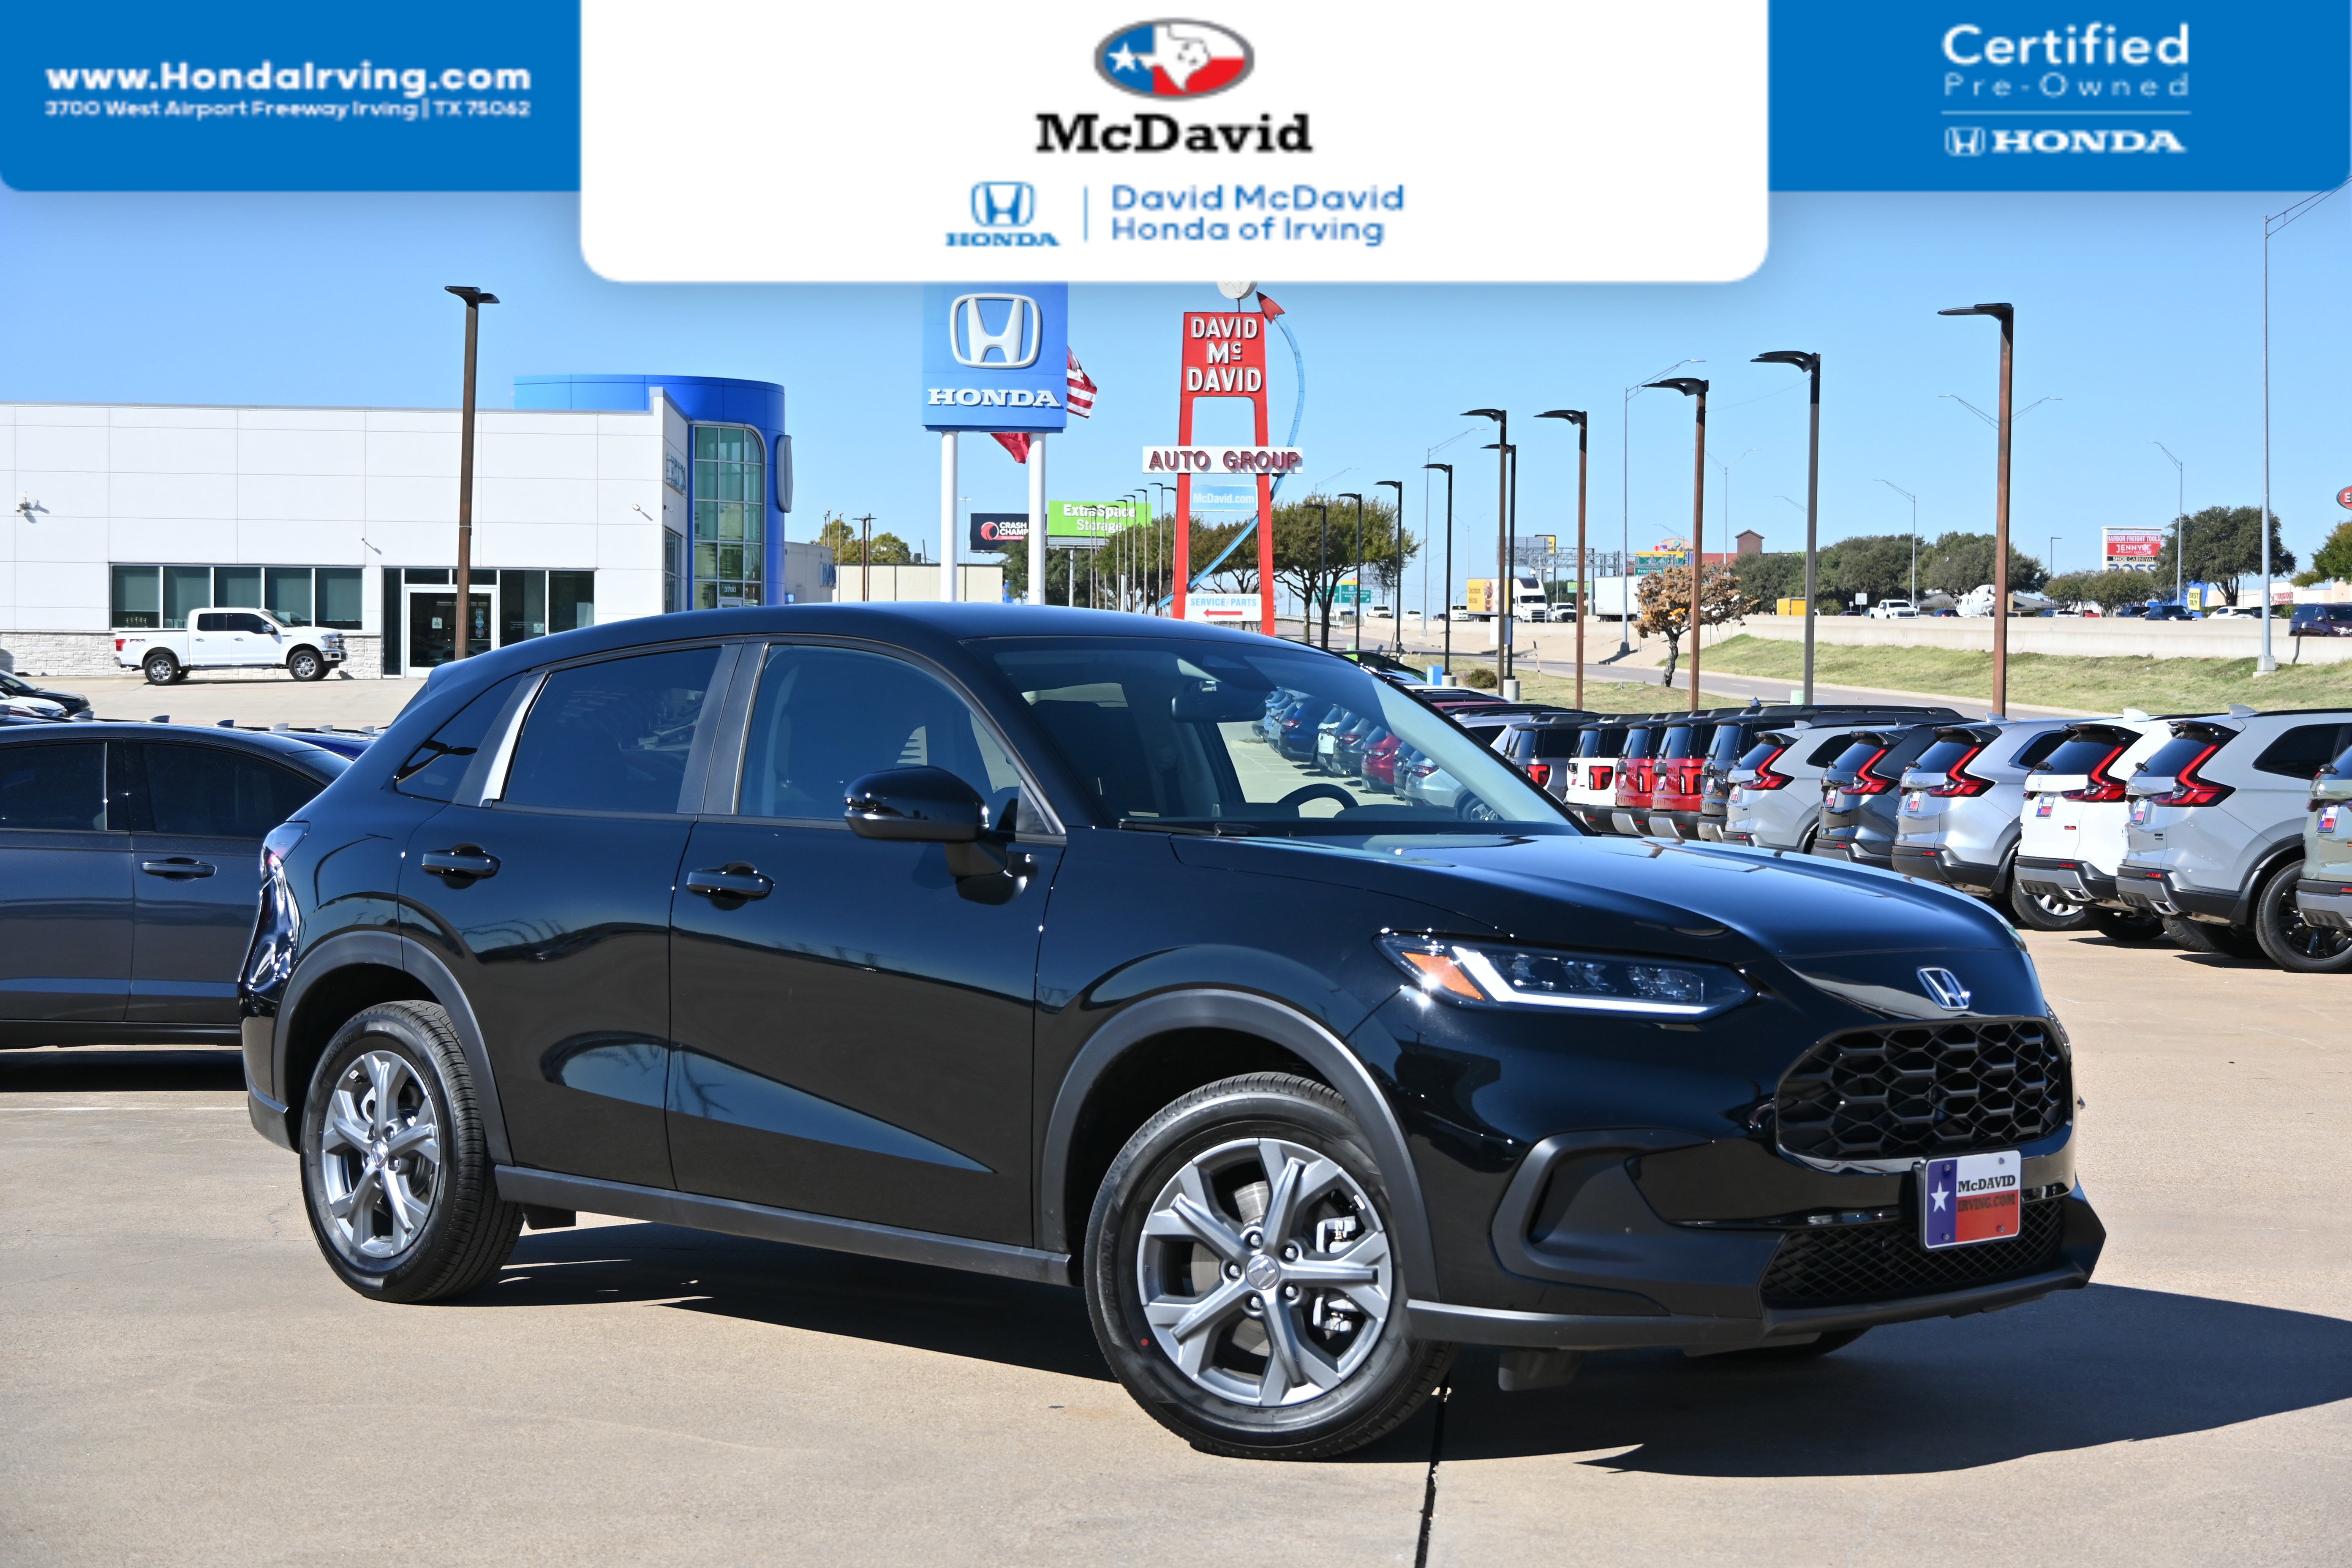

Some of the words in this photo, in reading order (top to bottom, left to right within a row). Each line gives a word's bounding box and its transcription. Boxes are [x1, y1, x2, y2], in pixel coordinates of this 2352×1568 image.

[1191, 317, 1258, 338] DAVID
[1187, 367, 1261, 391] DAVID
[928, 389, 1062, 406] HONDA
[1149, 450, 1209, 469] AUTO
[1223, 451, 1298, 470] GROUP
[1193, 493, 1254, 504] McDavid.com
[1077, 519, 1122, 534] Storage
[2116, 544, 2143, 553] JENNY
[1957, 1175, 2016, 1193] McDAVID
[1957, 1194, 2015, 1212] IRVING.COM
